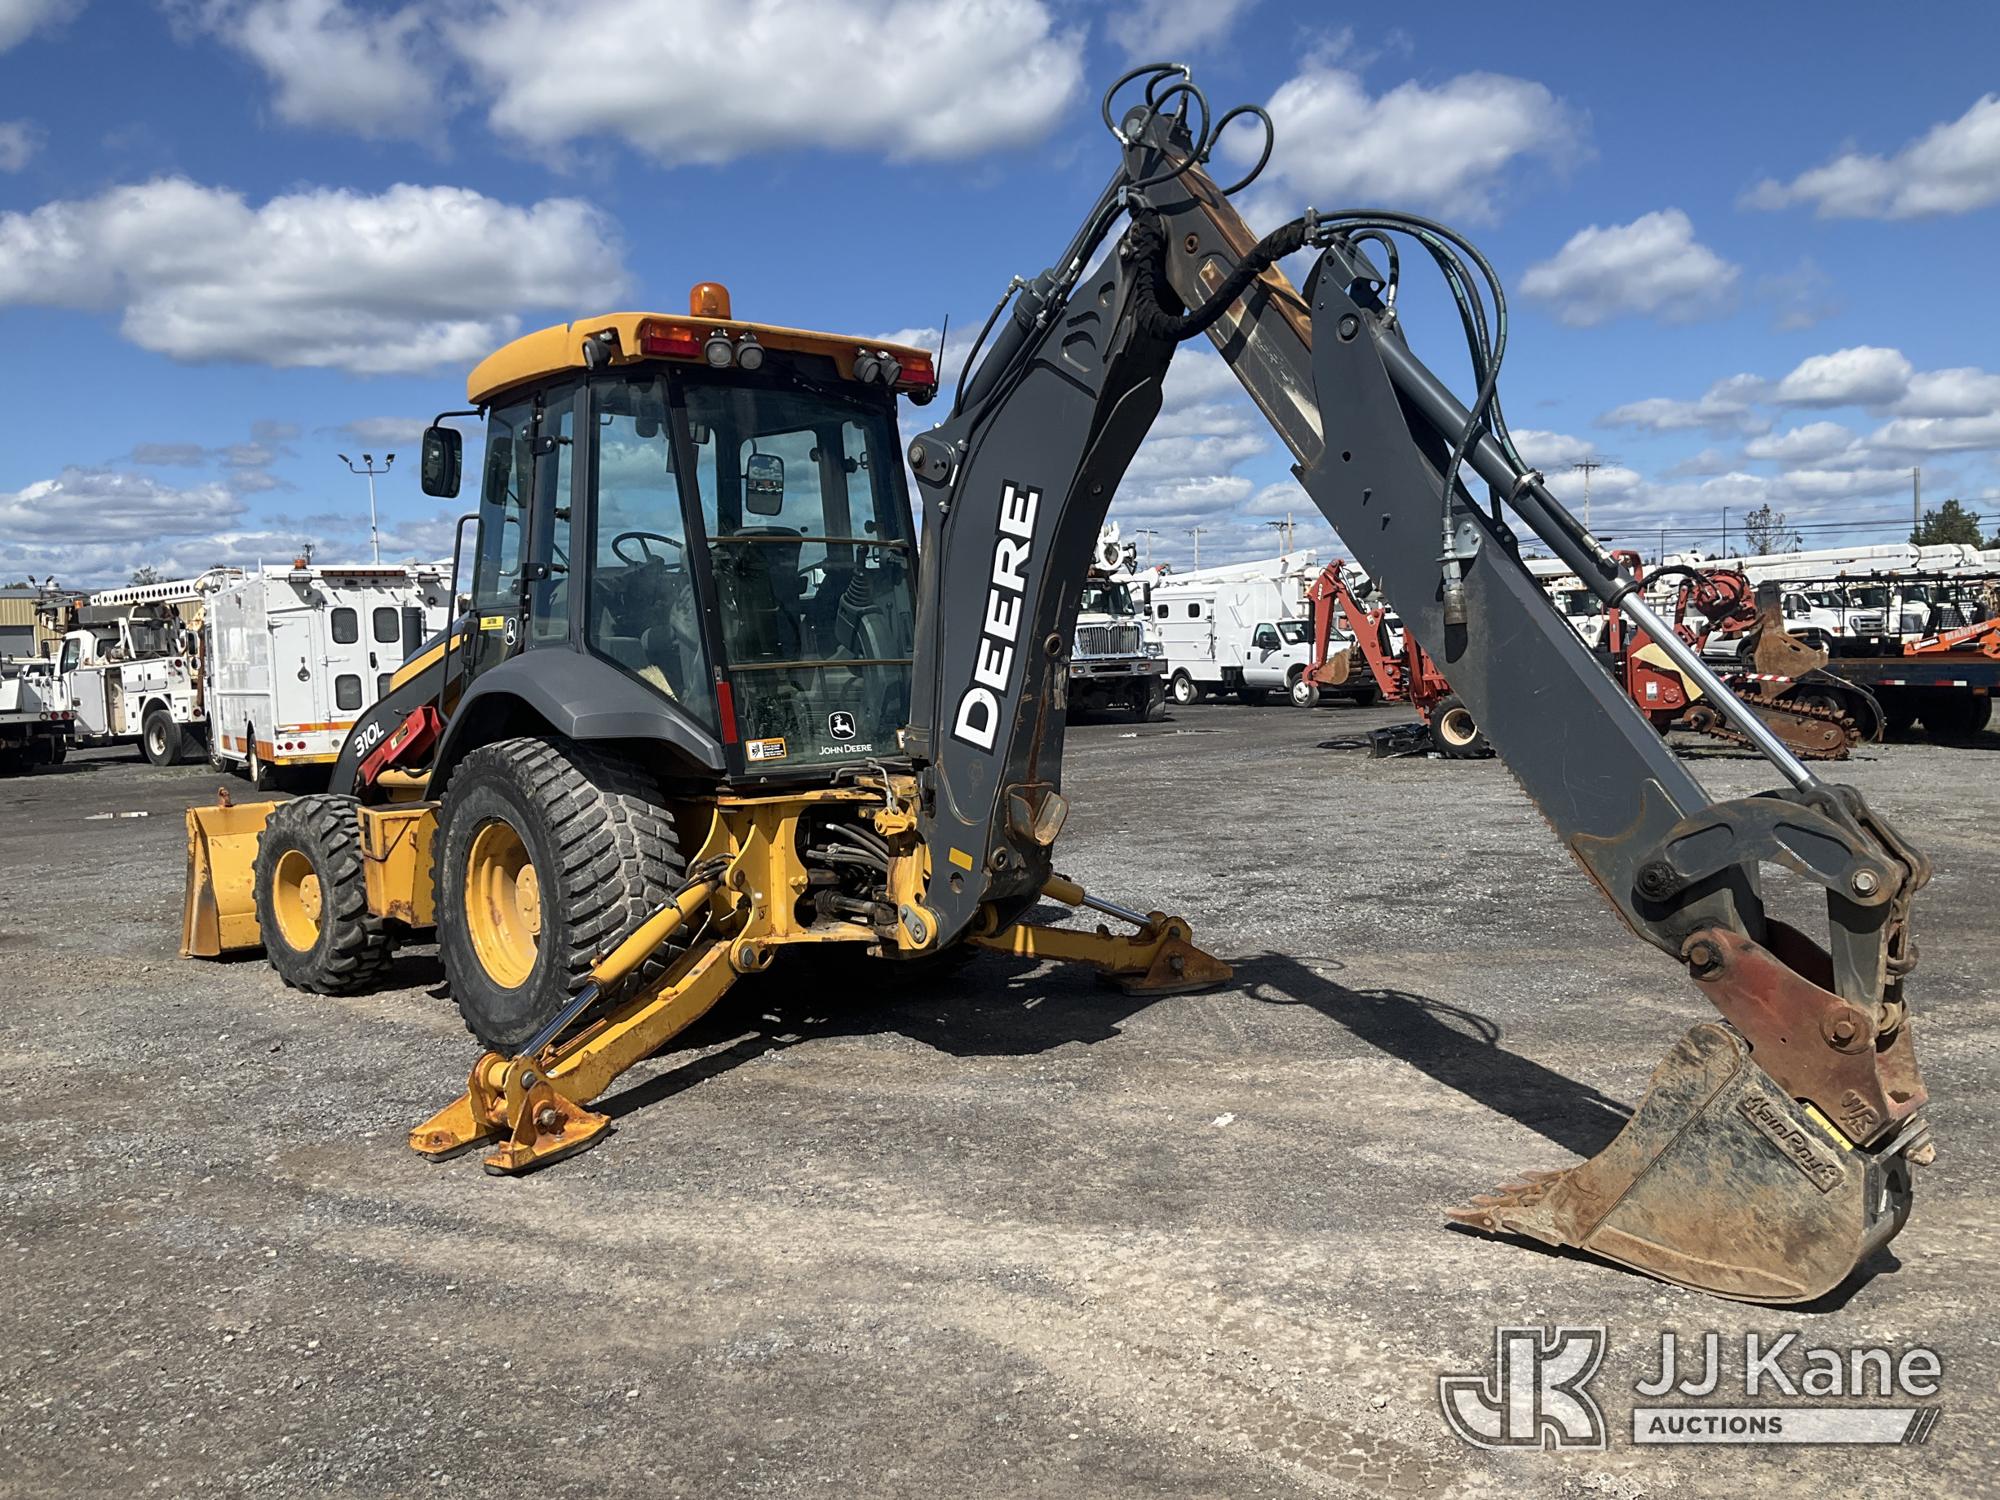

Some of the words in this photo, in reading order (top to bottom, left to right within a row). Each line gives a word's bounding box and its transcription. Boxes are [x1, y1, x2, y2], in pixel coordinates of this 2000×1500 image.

[954, 485, 1039, 750] DEERE
[354, 721, 385, 758] 310L
[818, 745, 844, 755] JOHN
[843, 743, 873, 753] DEERE
